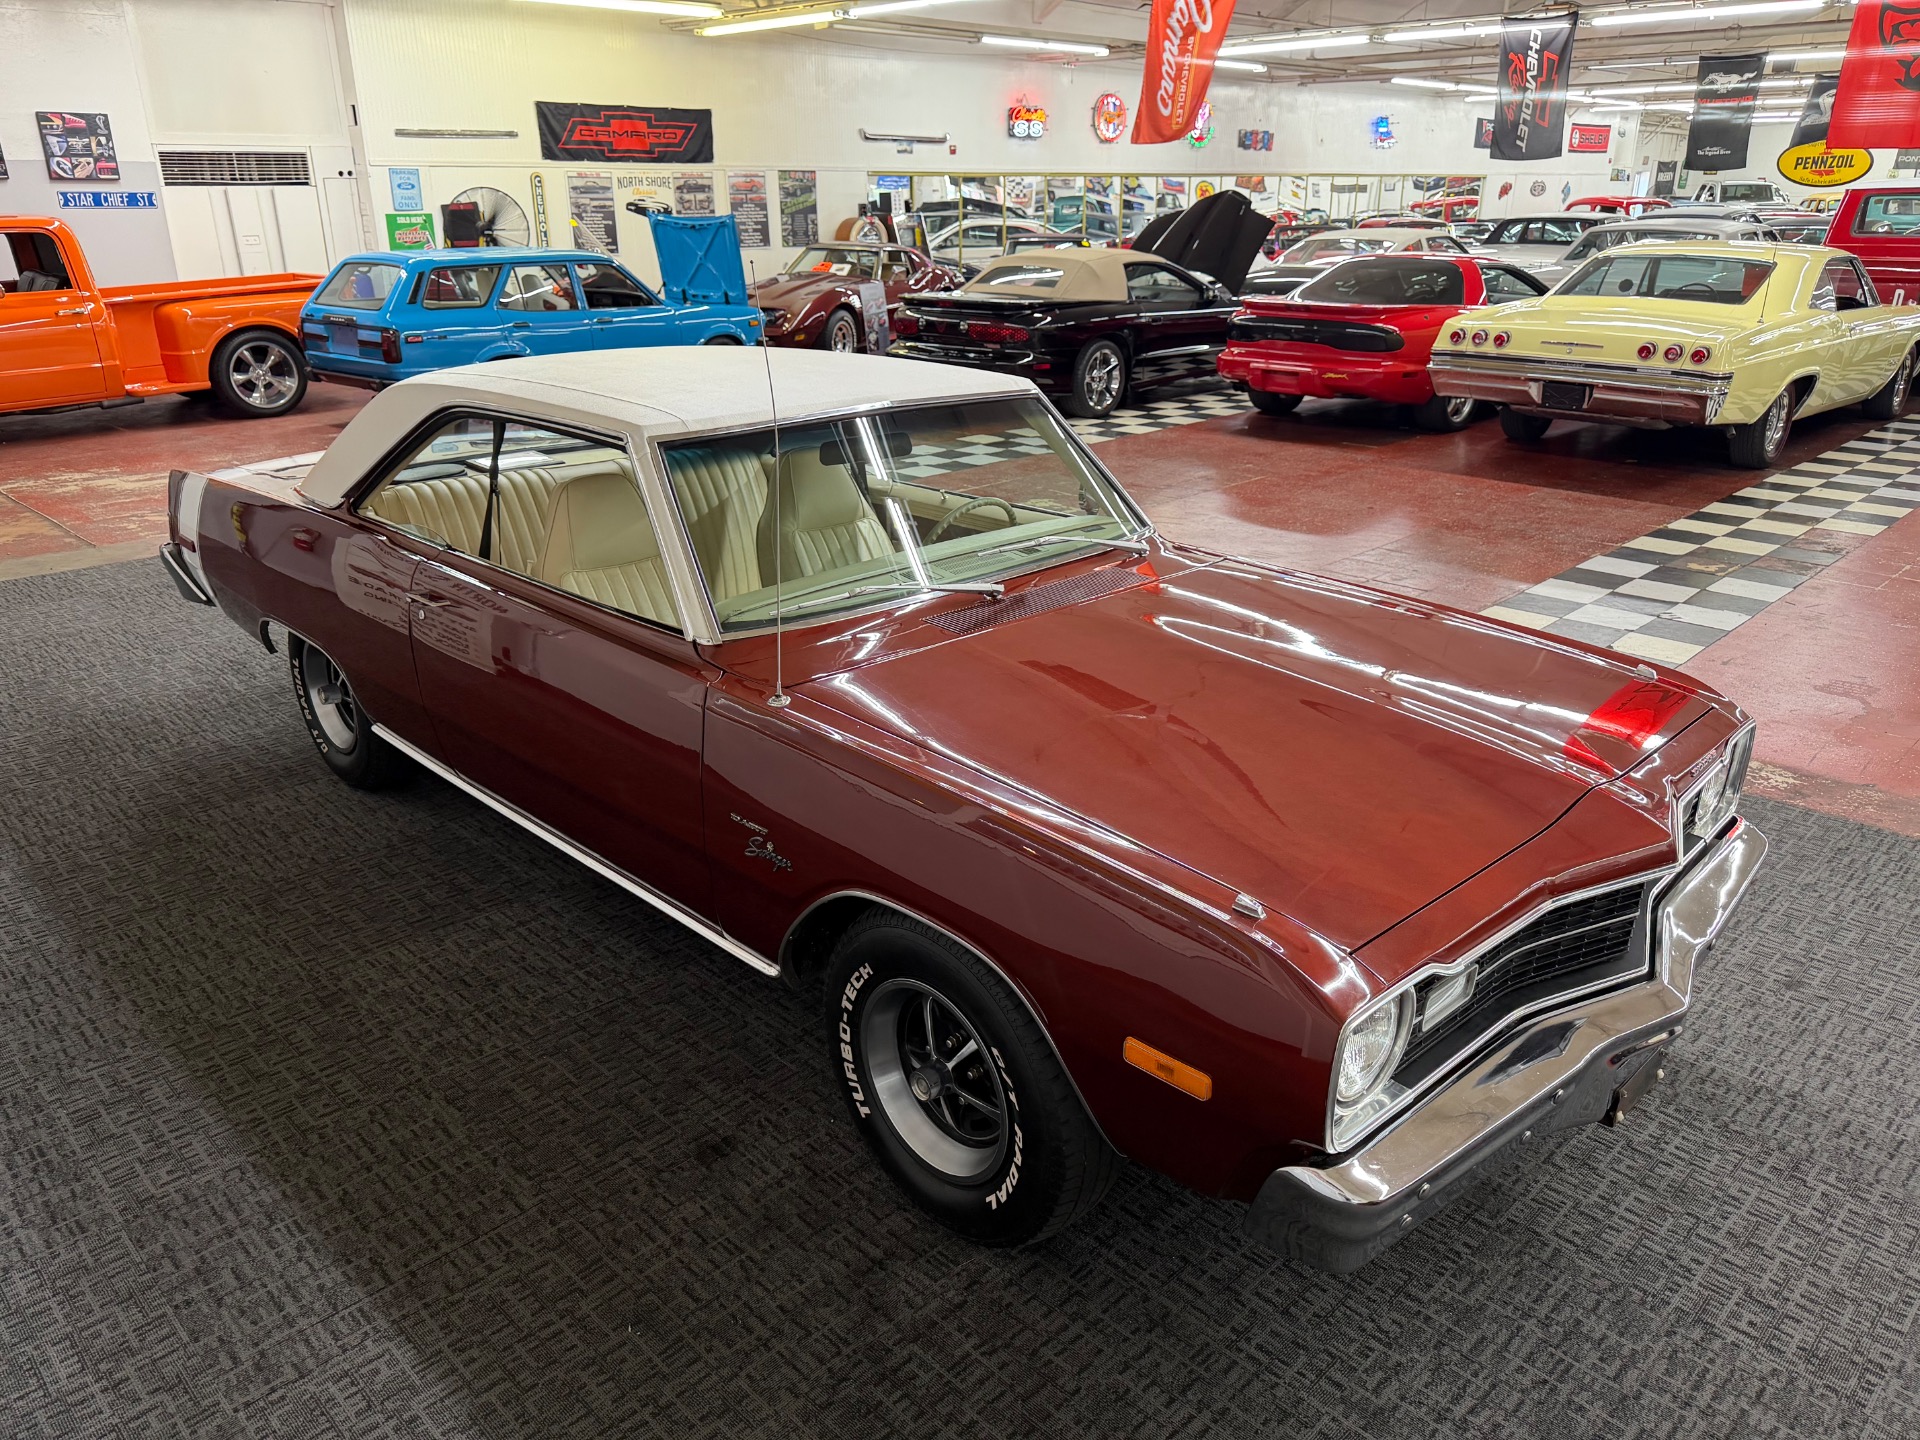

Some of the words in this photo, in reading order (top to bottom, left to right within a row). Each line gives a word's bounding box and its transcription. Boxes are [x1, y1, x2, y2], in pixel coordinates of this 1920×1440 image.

[1187, 36, 1195, 50] BY
[1176, 54, 1192, 124] CHEVROLET
[1504, 51, 1527, 129] Racing
[1516, 28, 1543, 153] CHEVROLET
[579, 129, 678, 141] CAMARO
[1013, 120, 1044, 138] SS
[1580, 132, 1608, 145] SHELBY
[1794, 155, 1855, 170] PENNZOIL
[617, 176, 643, 190] NORTH
[645, 176, 672, 190] SHORE
[632, 187, 657, 196] Classics
[67, 193, 94, 207] STAR
[101, 193, 129, 207] CHIEF
[136, 193, 150, 207] ST
[534, 177, 548, 248] CHEVROLE
[292, 657, 313, 720] RADIAL
[730, 812, 769, 836] DART
[839, 962, 874, 1119] TURBO-TECH
[985, 1123, 1024, 1211] RADIAL
